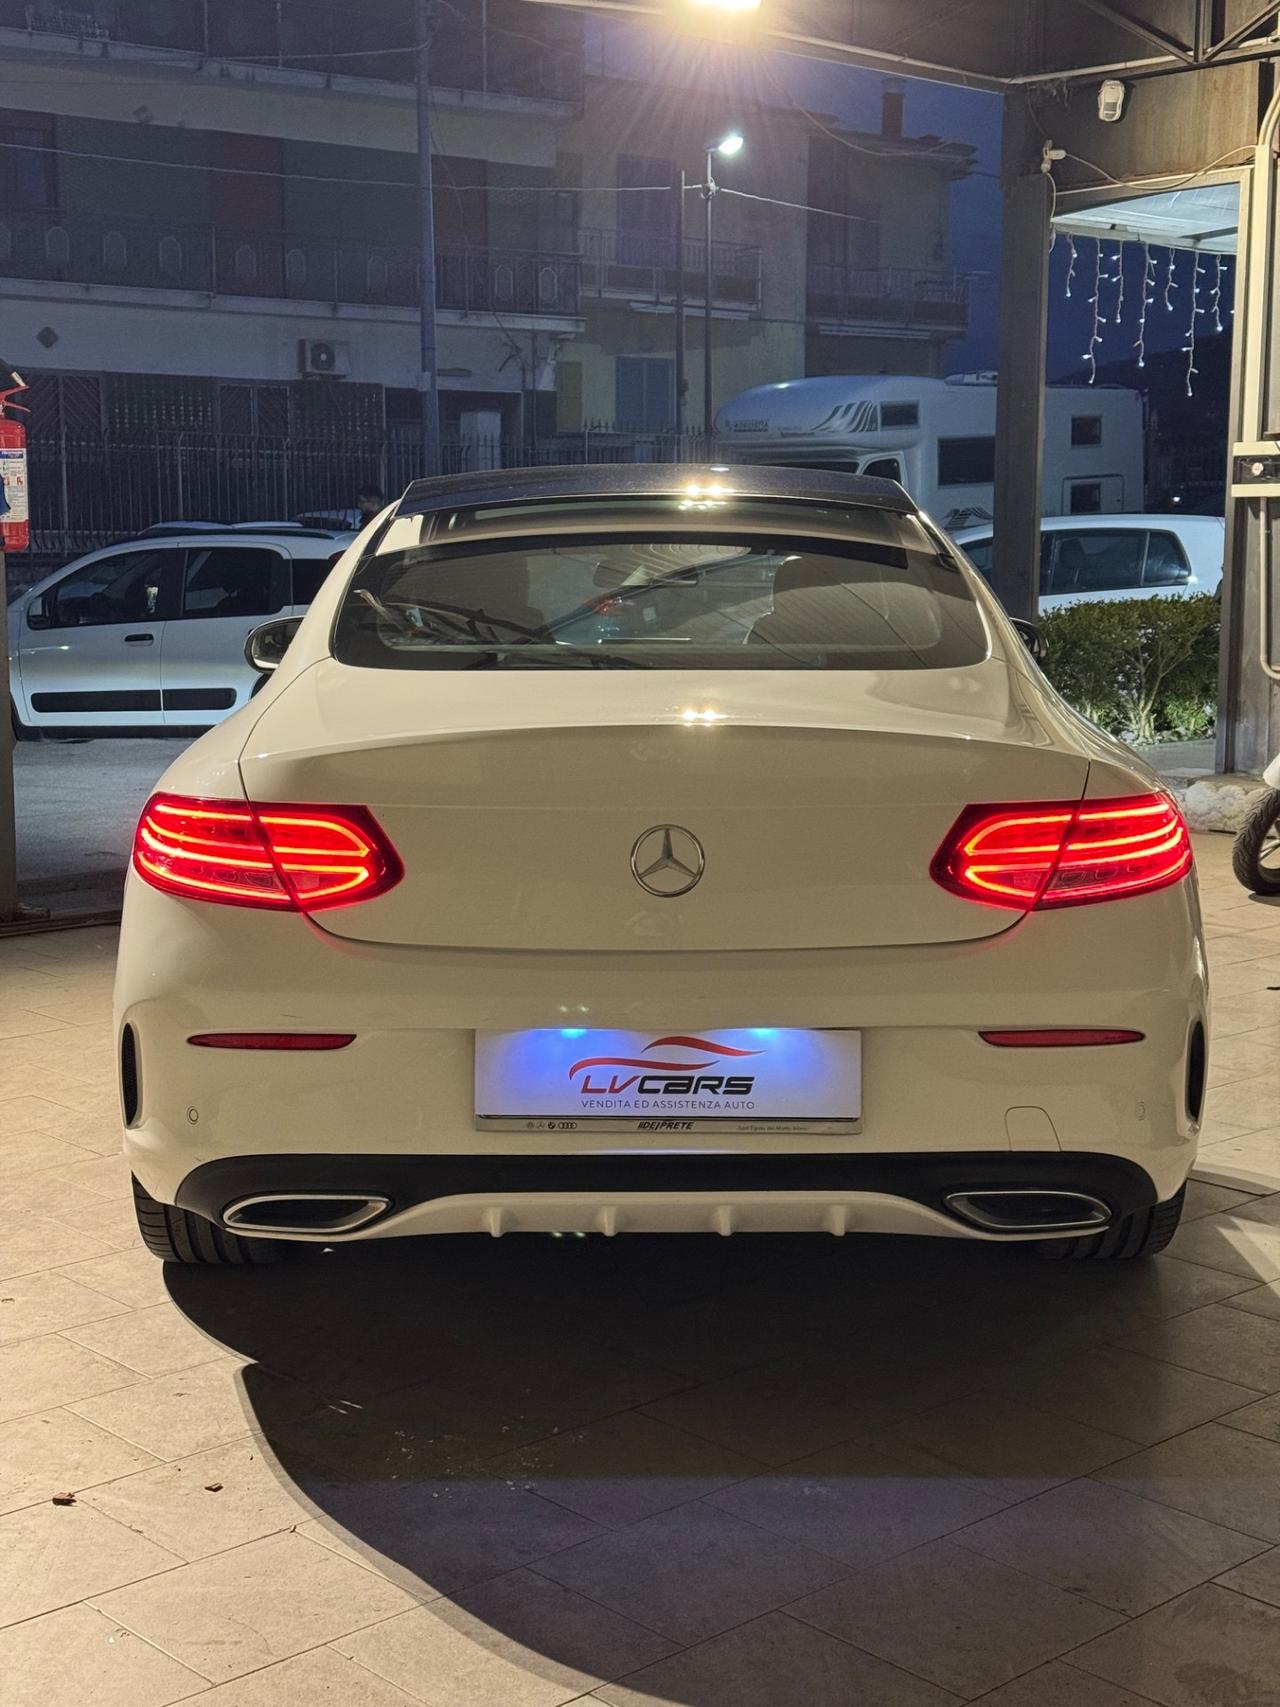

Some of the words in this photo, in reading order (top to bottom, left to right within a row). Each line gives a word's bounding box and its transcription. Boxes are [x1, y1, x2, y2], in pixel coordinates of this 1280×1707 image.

[581, 1100, 631, 1110] VENDITA
[634, 1100, 649, 1110] ED
[652, 1100, 721, 1110] ASSISTENZA
[724, 1101, 755, 1110] AUTO
